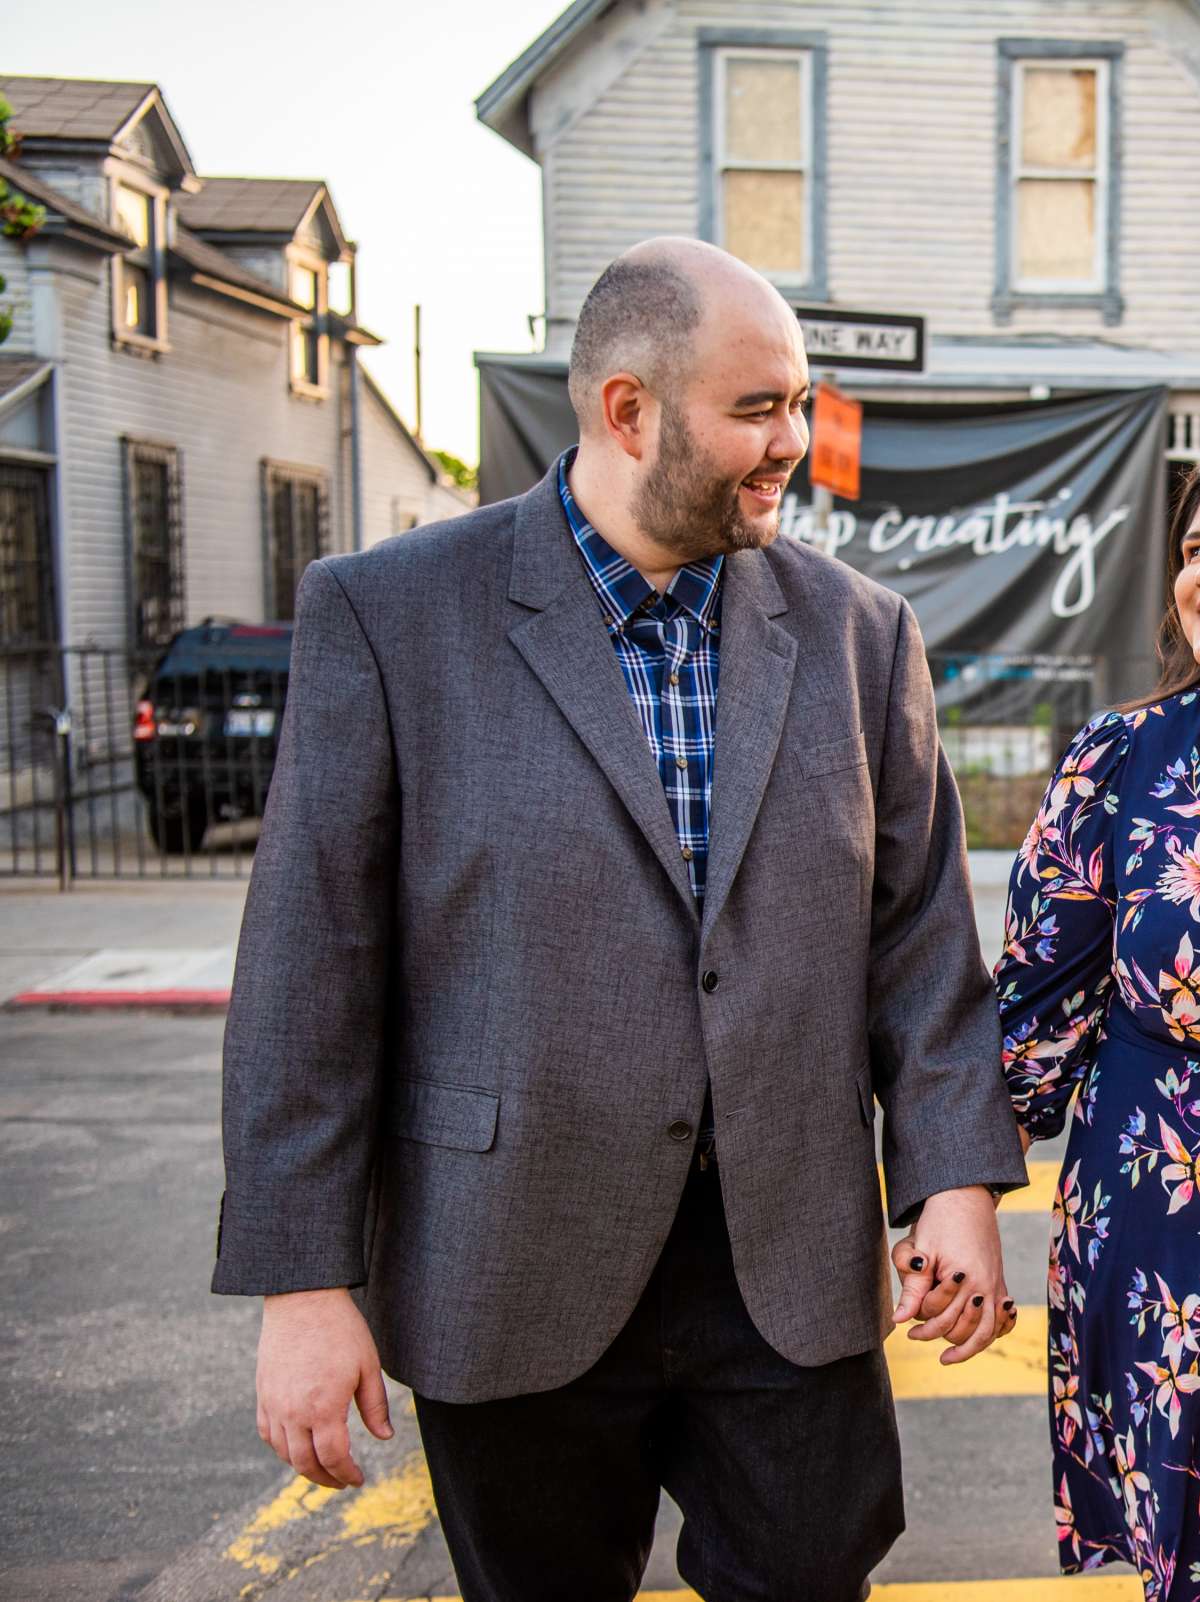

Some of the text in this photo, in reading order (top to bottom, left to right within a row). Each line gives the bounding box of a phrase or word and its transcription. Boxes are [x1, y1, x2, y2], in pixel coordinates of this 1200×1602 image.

[802, 325, 909, 353] NE WAY
[868, 487, 1130, 618] creating
